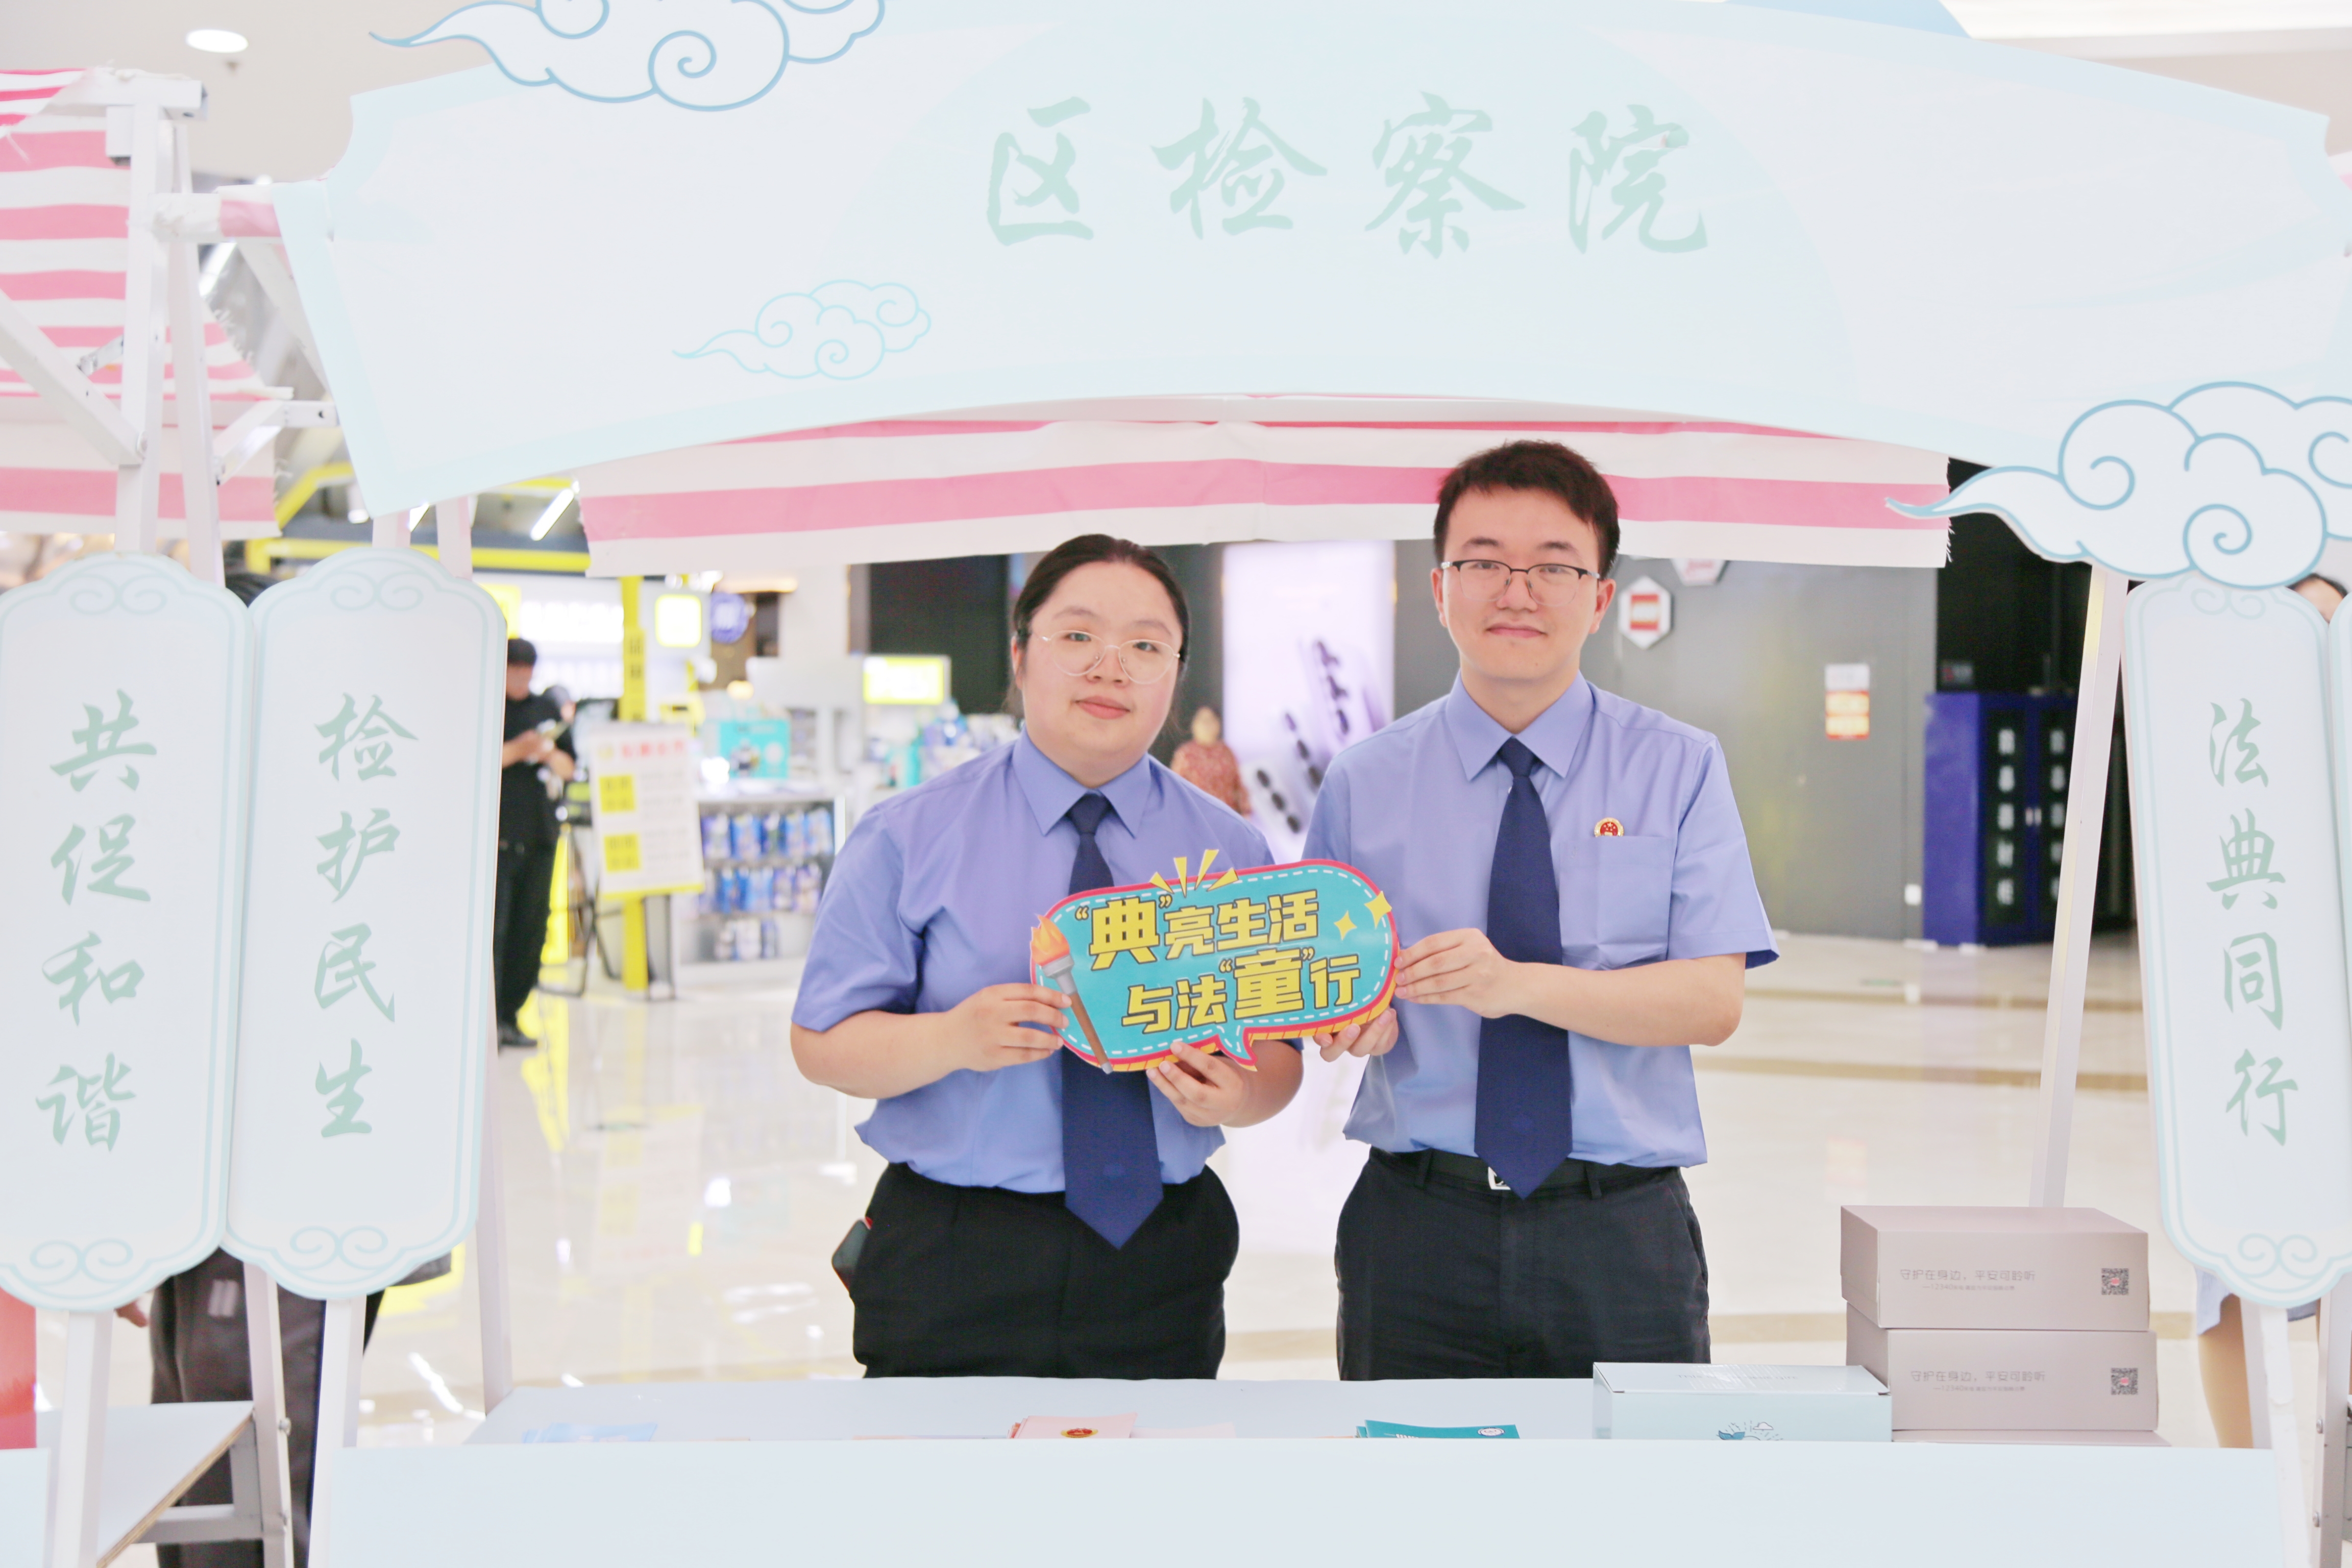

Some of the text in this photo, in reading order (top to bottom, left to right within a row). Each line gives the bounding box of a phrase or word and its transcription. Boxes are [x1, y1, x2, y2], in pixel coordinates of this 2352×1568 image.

[986, 90, 1709, 259] 区检察院
[36, 689, 157, 1151] 共促和谐
[314, 693, 419, 1138] 检护民生
[1074, 889, 1319, 970] “典”亮生活
[1121, 948, 1361, 1035] 与法“童”行
[2207, 697, 2298, 1146] 法典同行
